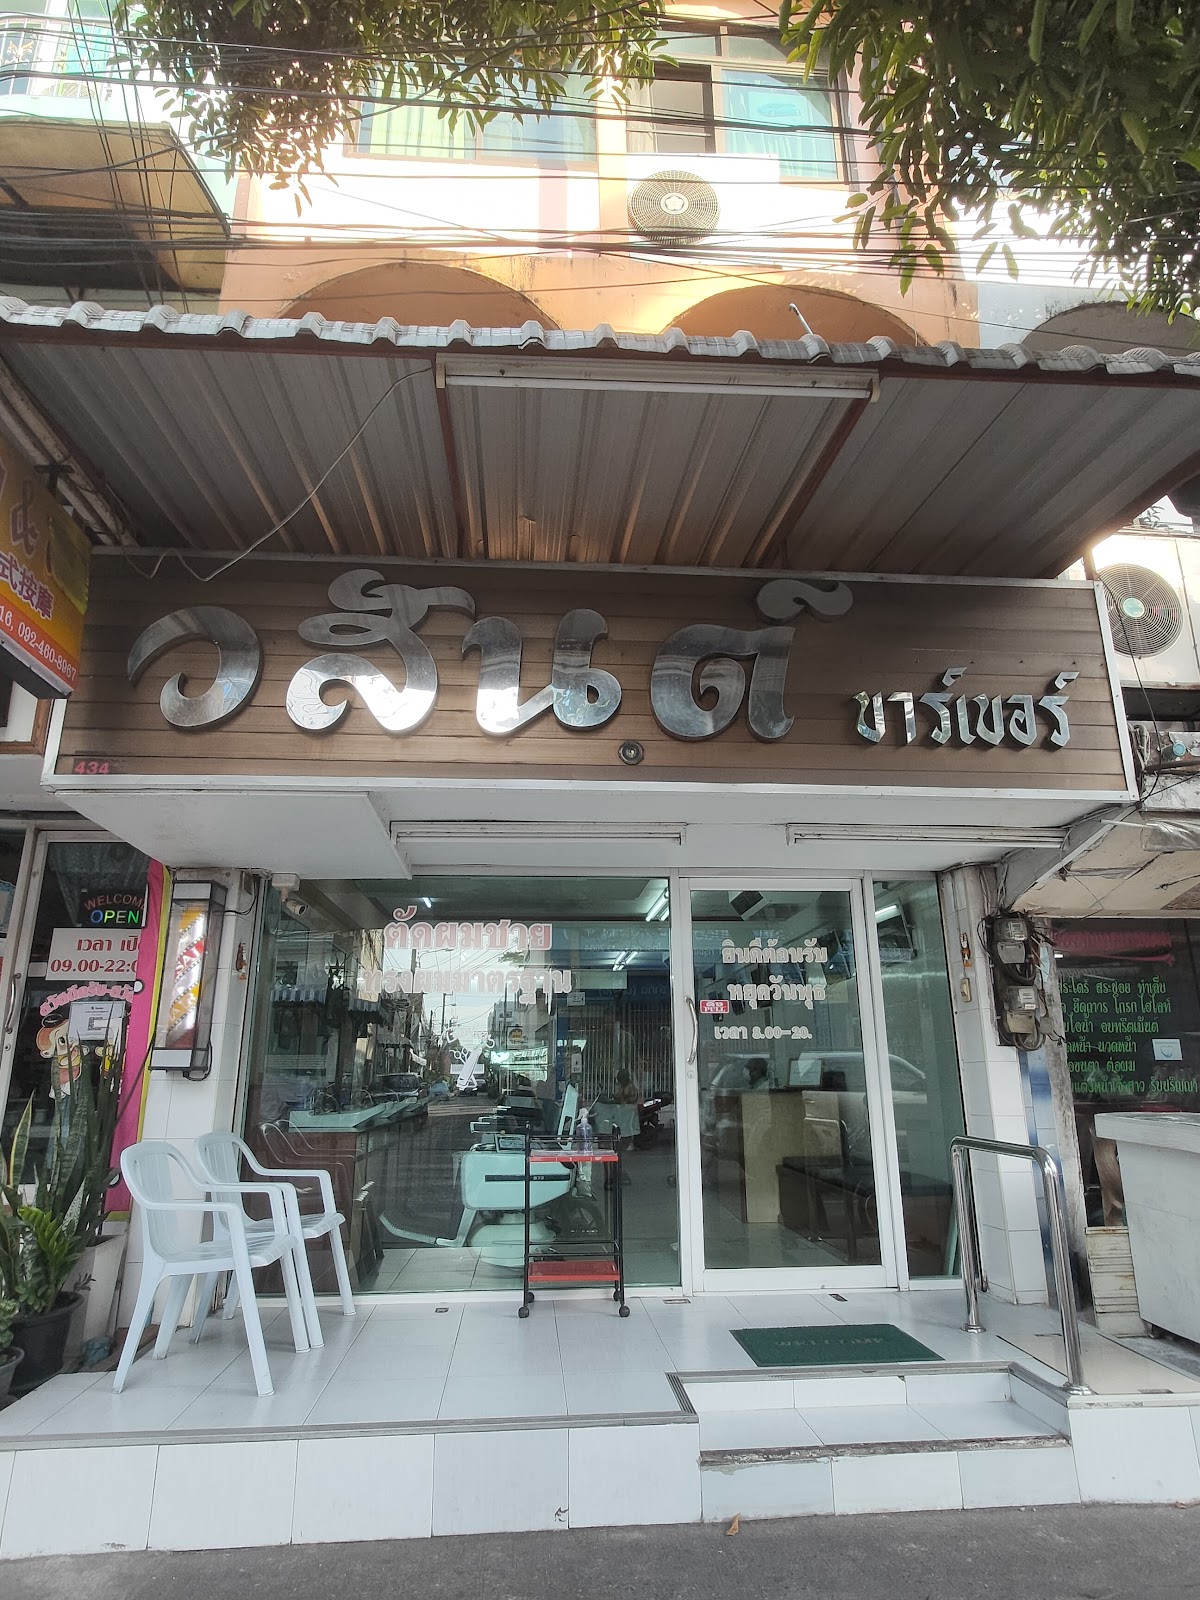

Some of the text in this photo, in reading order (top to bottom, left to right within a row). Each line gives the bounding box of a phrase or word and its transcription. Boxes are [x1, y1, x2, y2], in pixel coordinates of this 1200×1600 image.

[17, 620, 77, 683] 092-460-8967
[127, 567, 1080, 749] วสันต์ บาร์เบอร์
[74, 760, 110, 774] 434
[90, 909, 140, 924] OPEN
[383, 905, 553, 950] ตัดผมชาย
[77, 935, 141, 952] เวลา เปิ
[721, 937, 828, 963] ยินดีต้อนรับ
[726, 975, 826, 1010] หยุดวันพุธ
[714, 1026, 748, 1039] เวลา
